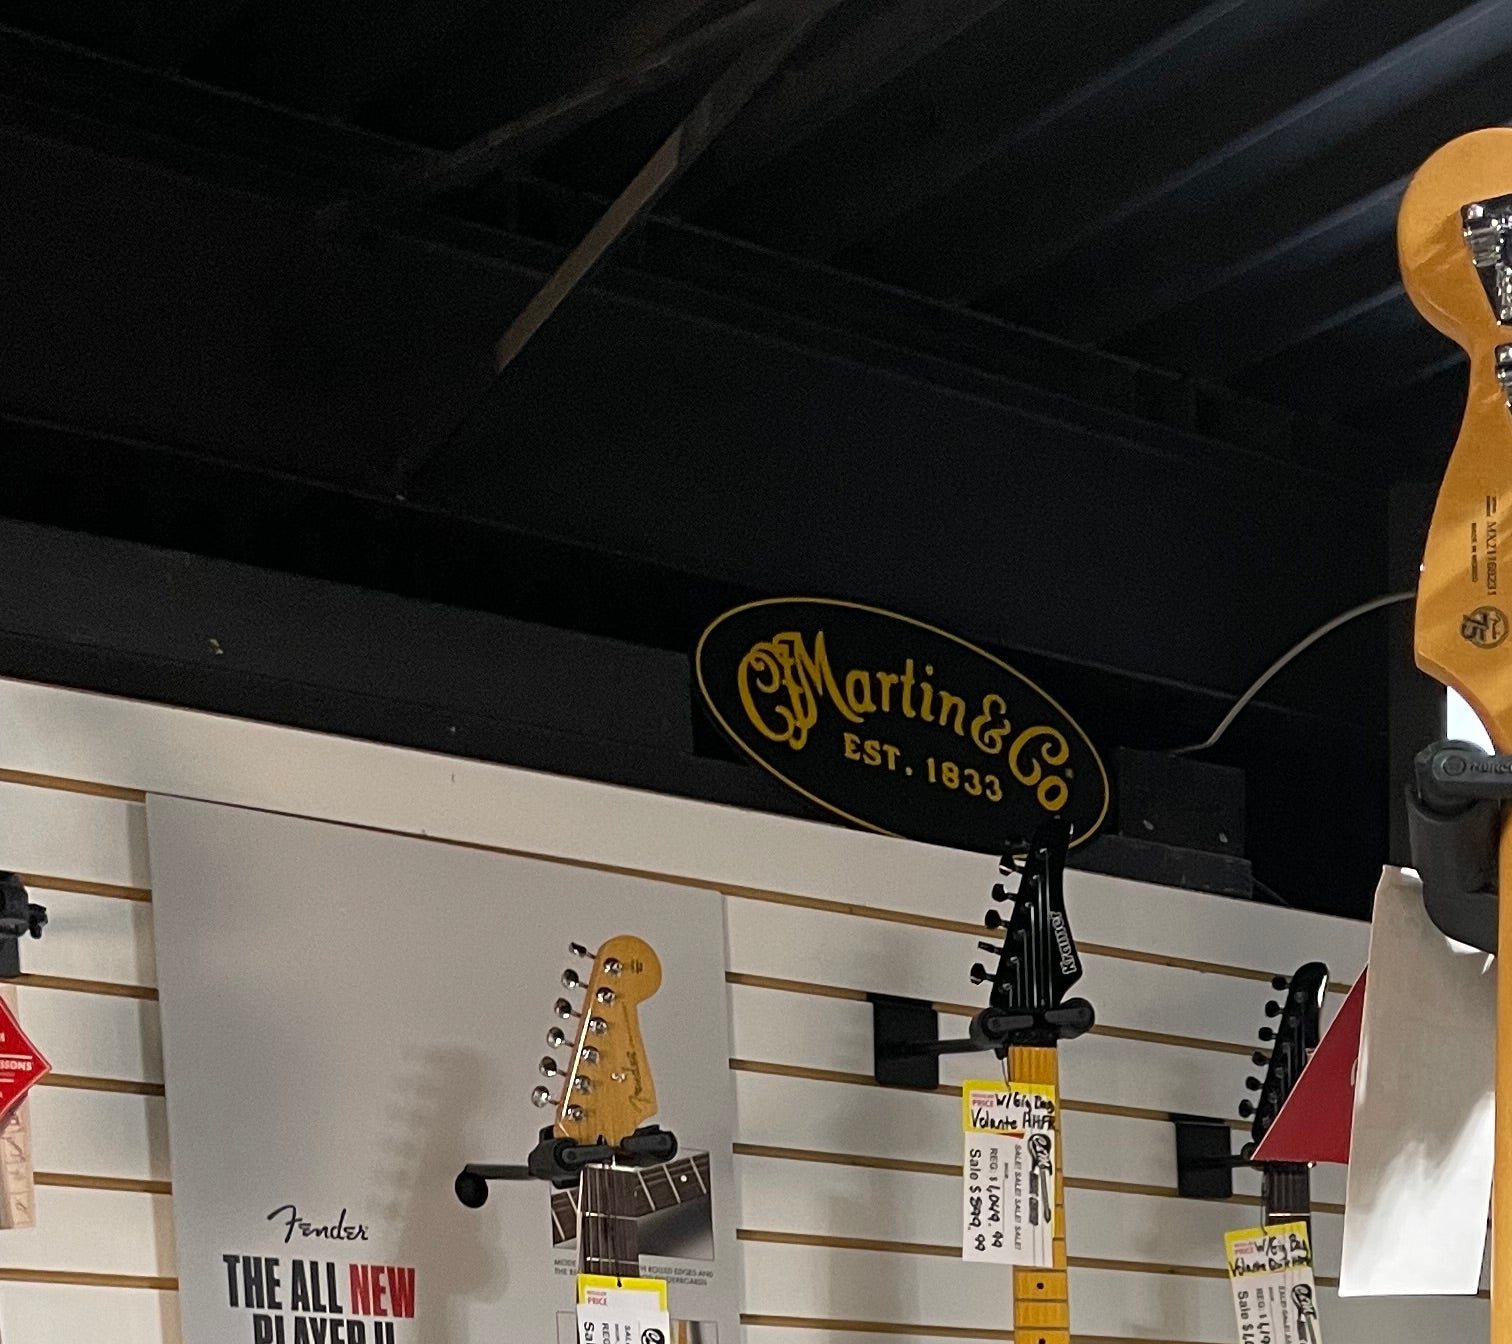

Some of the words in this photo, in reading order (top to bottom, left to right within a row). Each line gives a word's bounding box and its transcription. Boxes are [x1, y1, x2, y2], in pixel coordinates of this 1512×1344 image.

[843, 732, 913, 776] EST.
[927, 757, 1002, 801] 1833
[1049, 911, 1078, 975] Kramer
[969, 1149, 981, 1180] Sale
[267, 1204, 369, 1244] Fender
[222, 1254, 282, 1310] THE
[291, 1259, 343, 1314] ALL
[349, 1263, 415, 1318] NEW
[588, 1297, 607, 1305] PRICE
[1238, 1291, 1249, 1320] Sale
